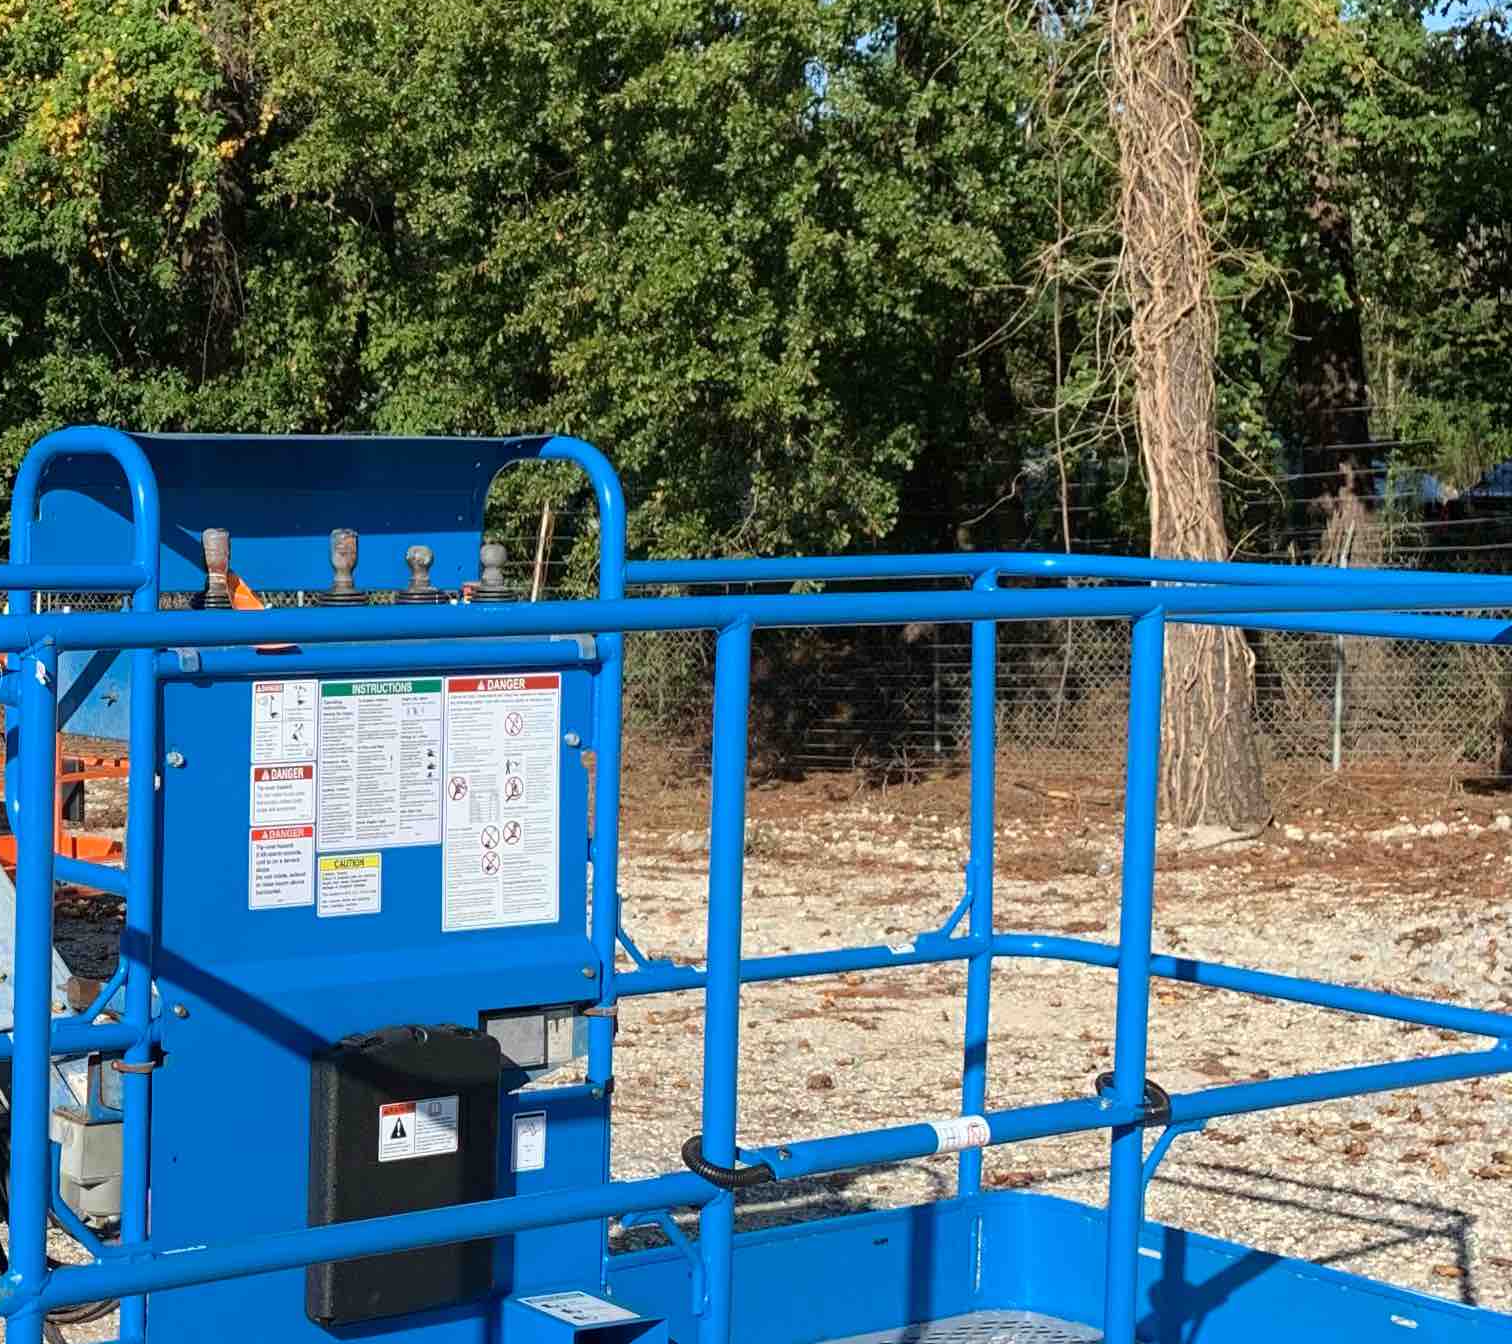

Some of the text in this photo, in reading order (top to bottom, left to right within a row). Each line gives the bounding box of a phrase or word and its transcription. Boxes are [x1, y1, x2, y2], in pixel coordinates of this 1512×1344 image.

[352, 681, 413, 695] INSTRUCTIONS
[488, 678, 526, 691] DANGER
[271, 767, 304, 780] DANGER
[334, 858, 365, 869] CAUTION
